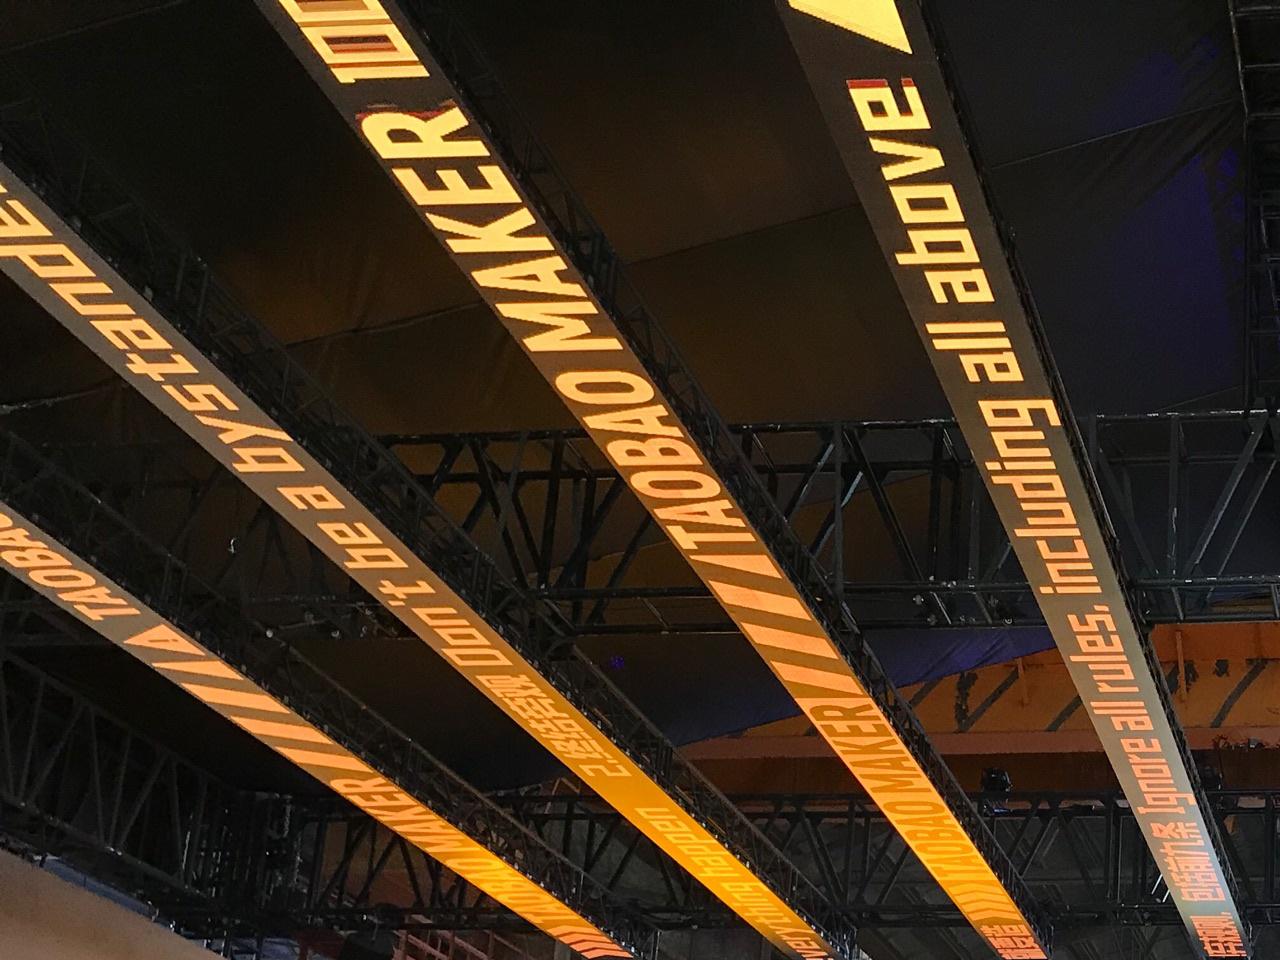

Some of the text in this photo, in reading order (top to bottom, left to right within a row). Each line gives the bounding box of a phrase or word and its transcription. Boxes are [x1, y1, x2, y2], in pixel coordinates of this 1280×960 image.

[0, 178, 345, 510] a bystande
[358, 105, 757, 556] TAOBAO MAKER
[846, 77, 1103, 595] including all above
[0, 511, 140, 622] TAOBA
[316, 522, 513, 666] Don't be
[476, 674, 632, 777] 2.终结旁观
[1067, 604, 1198, 814] Ignore all rules,
[331, 778, 467, 854] MAKER
[810, 704, 991, 880] TAOBAO MAKER
[635, 807, 834, 960] verything happen
